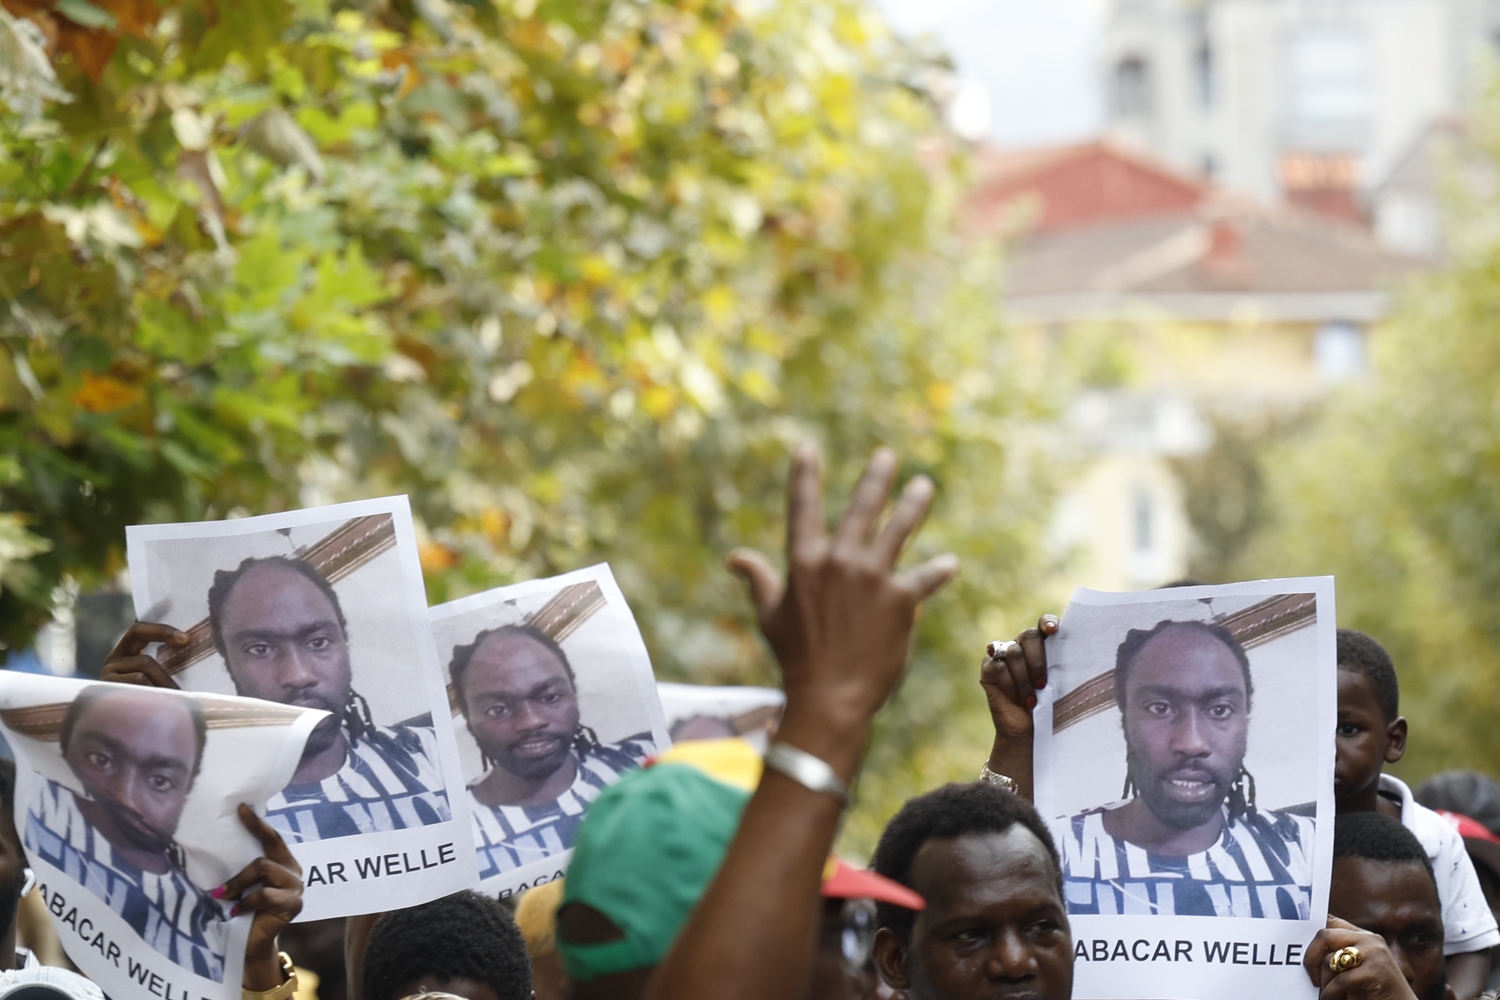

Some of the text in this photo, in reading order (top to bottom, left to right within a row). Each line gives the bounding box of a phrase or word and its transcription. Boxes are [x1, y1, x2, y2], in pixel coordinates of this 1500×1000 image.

[354, 842, 456, 880] WELLE
[1074, 939, 1303, 966] ABACAR WELLE
